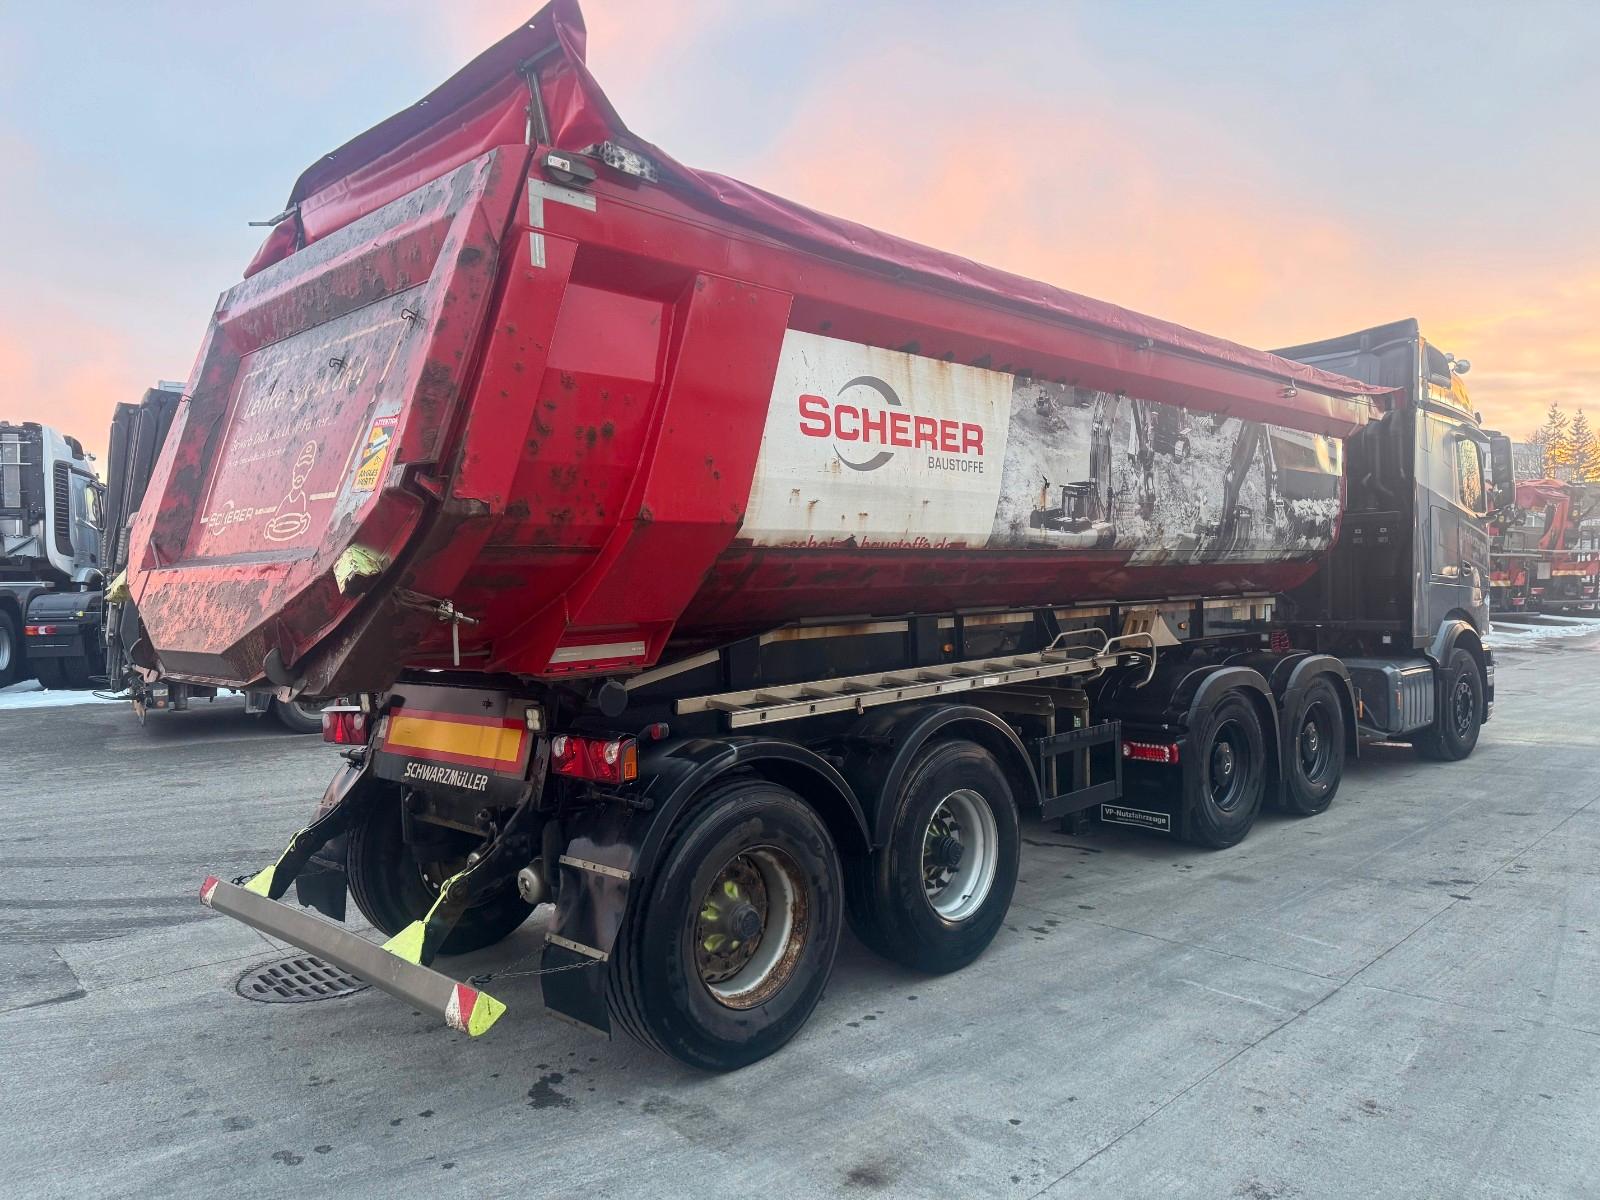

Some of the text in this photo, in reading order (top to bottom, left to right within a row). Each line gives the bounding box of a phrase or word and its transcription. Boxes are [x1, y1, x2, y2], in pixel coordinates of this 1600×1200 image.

[243, 382, 290, 420] Lenke
[798, 394, 984, 456] SCHERER
[928, 457, 984, 474] BAUSTOFFE
[404, 762, 488, 791] SCHWARZMÜLLER
[1105, 808, 1166, 824] VP-Nutzfahrzeuge
